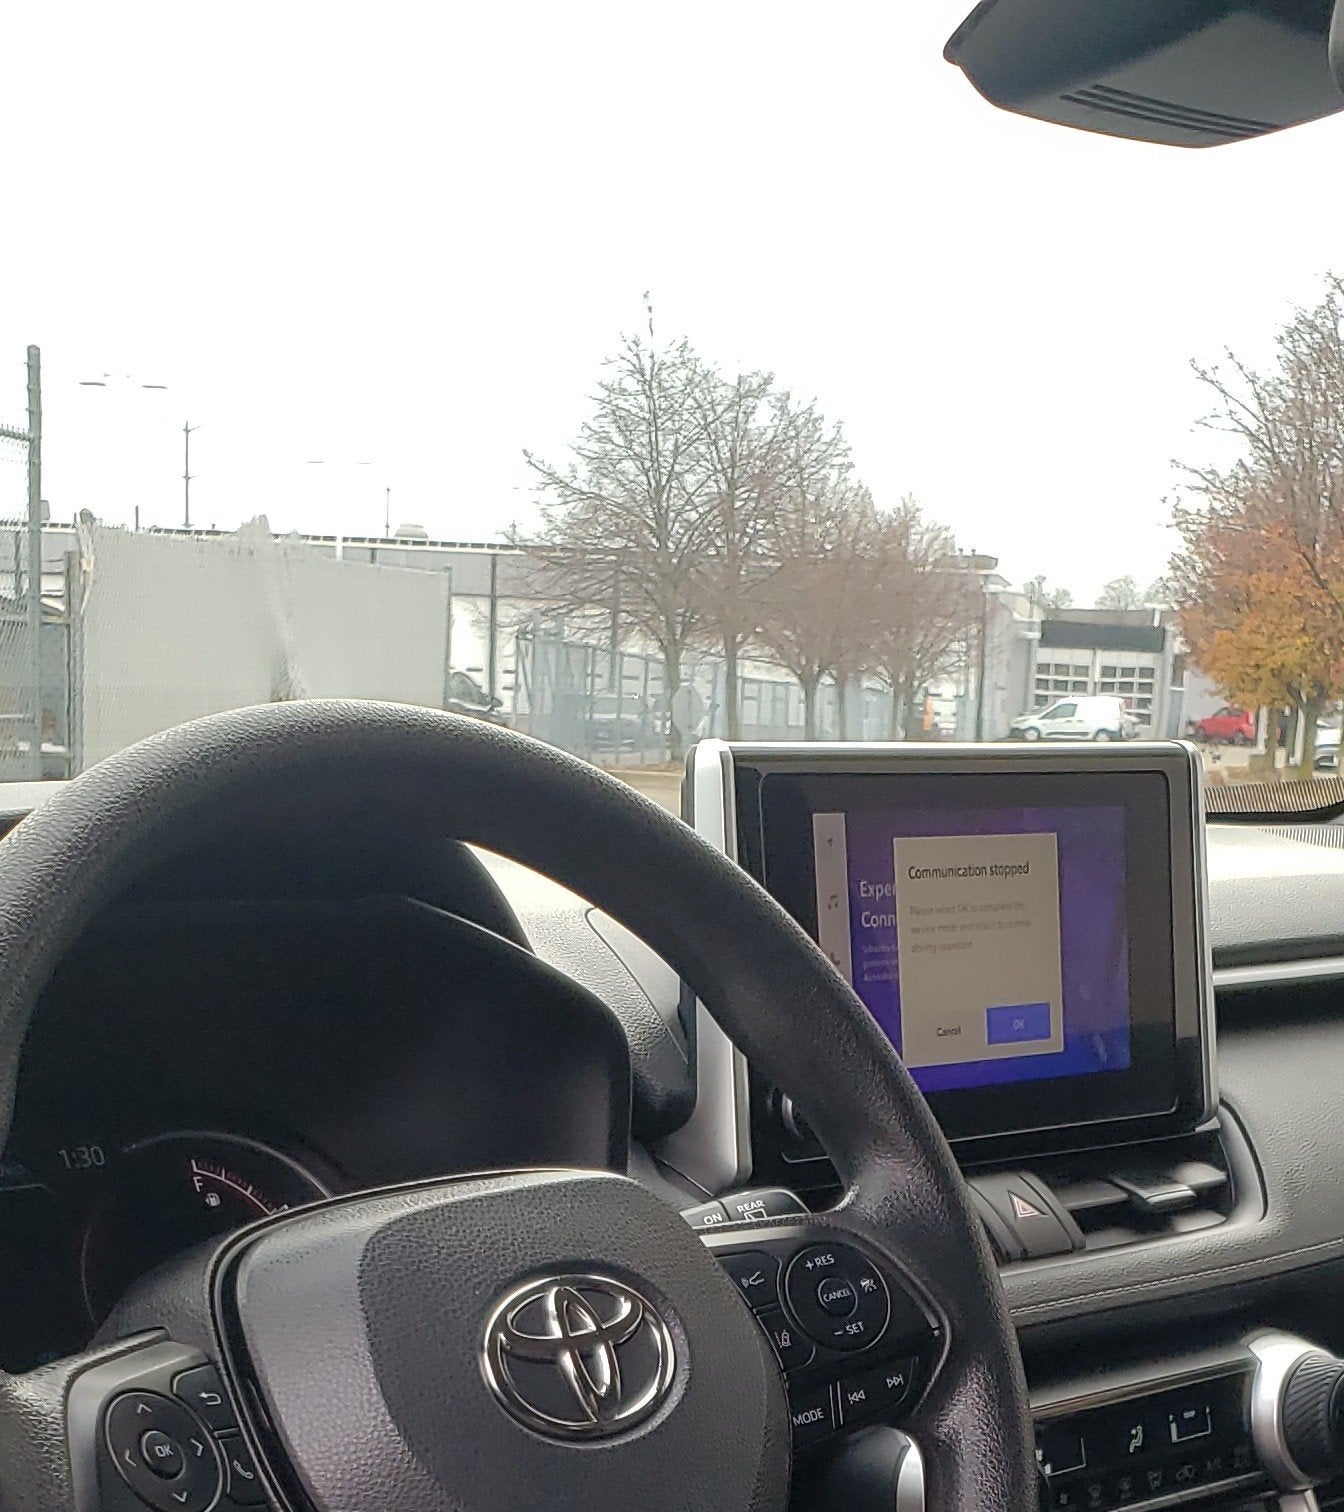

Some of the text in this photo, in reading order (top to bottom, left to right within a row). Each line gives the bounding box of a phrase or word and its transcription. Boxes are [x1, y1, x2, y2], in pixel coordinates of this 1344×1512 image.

[908, 861, 1030, 880] Communication stopped
[58, 1146, 105, 1169] 1:30
[193, 1176, 204, 1193] F
[736, 1200, 766, 1213] REAR
[703, 1213, 723, 1225] ON
[822, 1288, 852, 1302] CANCEL
[845, 1321, 864, 1335] SET
[792, 1407, 824, 1426] MODE
[154, 1444, 174, 1458] OK
